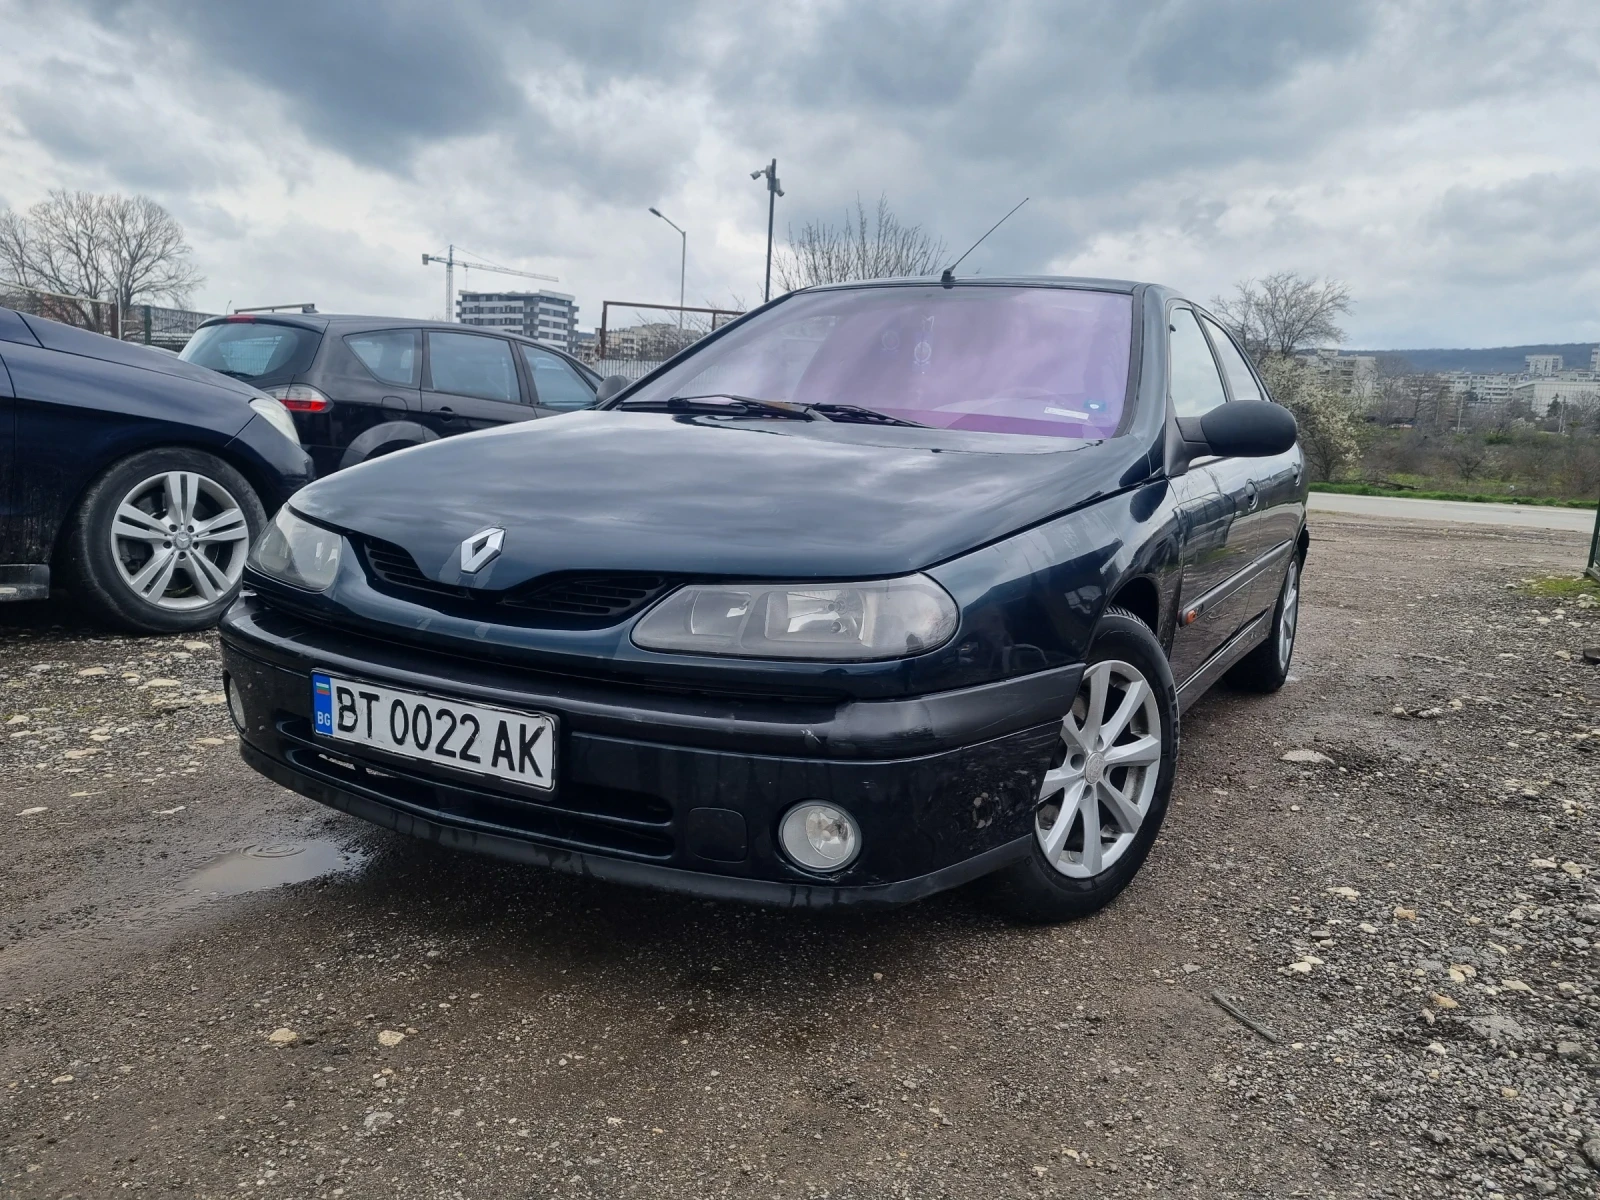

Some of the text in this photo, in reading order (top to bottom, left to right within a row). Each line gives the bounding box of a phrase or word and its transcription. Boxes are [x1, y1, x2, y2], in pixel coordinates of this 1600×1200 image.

[317, 711, 331, 726] BG
[336, 685, 546, 778] BT 0022 AK
